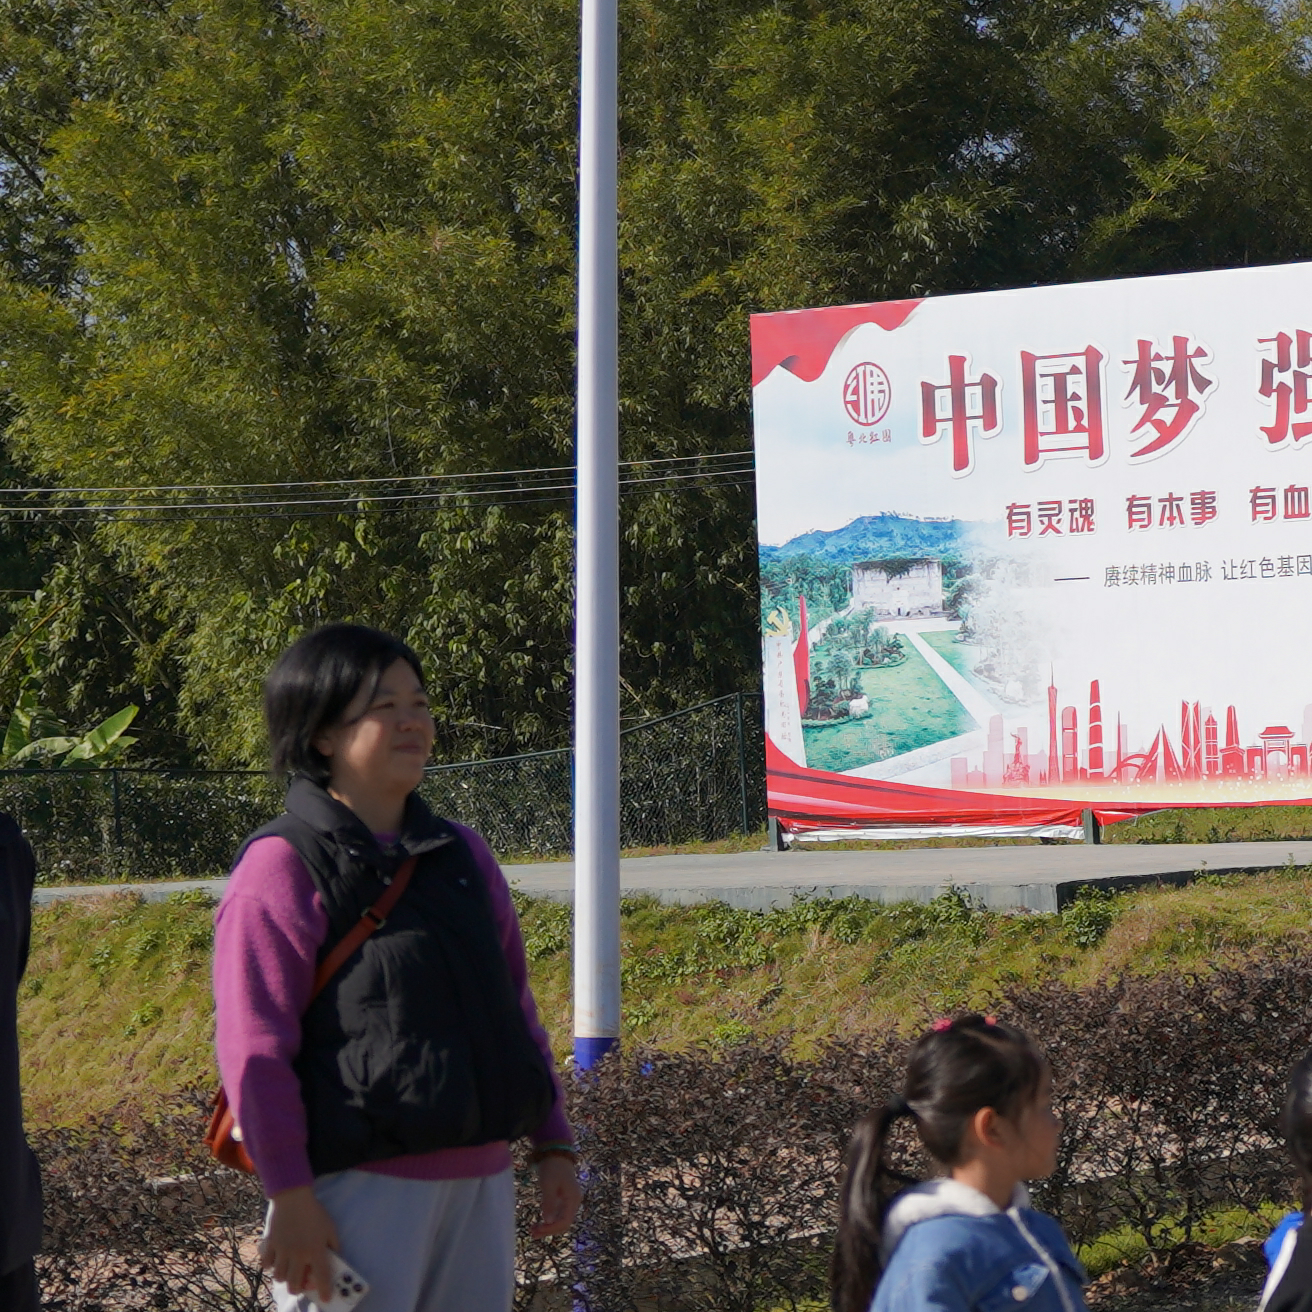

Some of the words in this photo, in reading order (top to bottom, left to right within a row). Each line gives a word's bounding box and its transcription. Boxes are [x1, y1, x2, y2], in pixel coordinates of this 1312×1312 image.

[920, 334, 1211, 473] 中国梦
[1005, 497, 1096, 538] 有灵魂
[1125, 489, 1219, 530] 有本事
[1103, 560, 1213, 588] 赓续精神血脉
